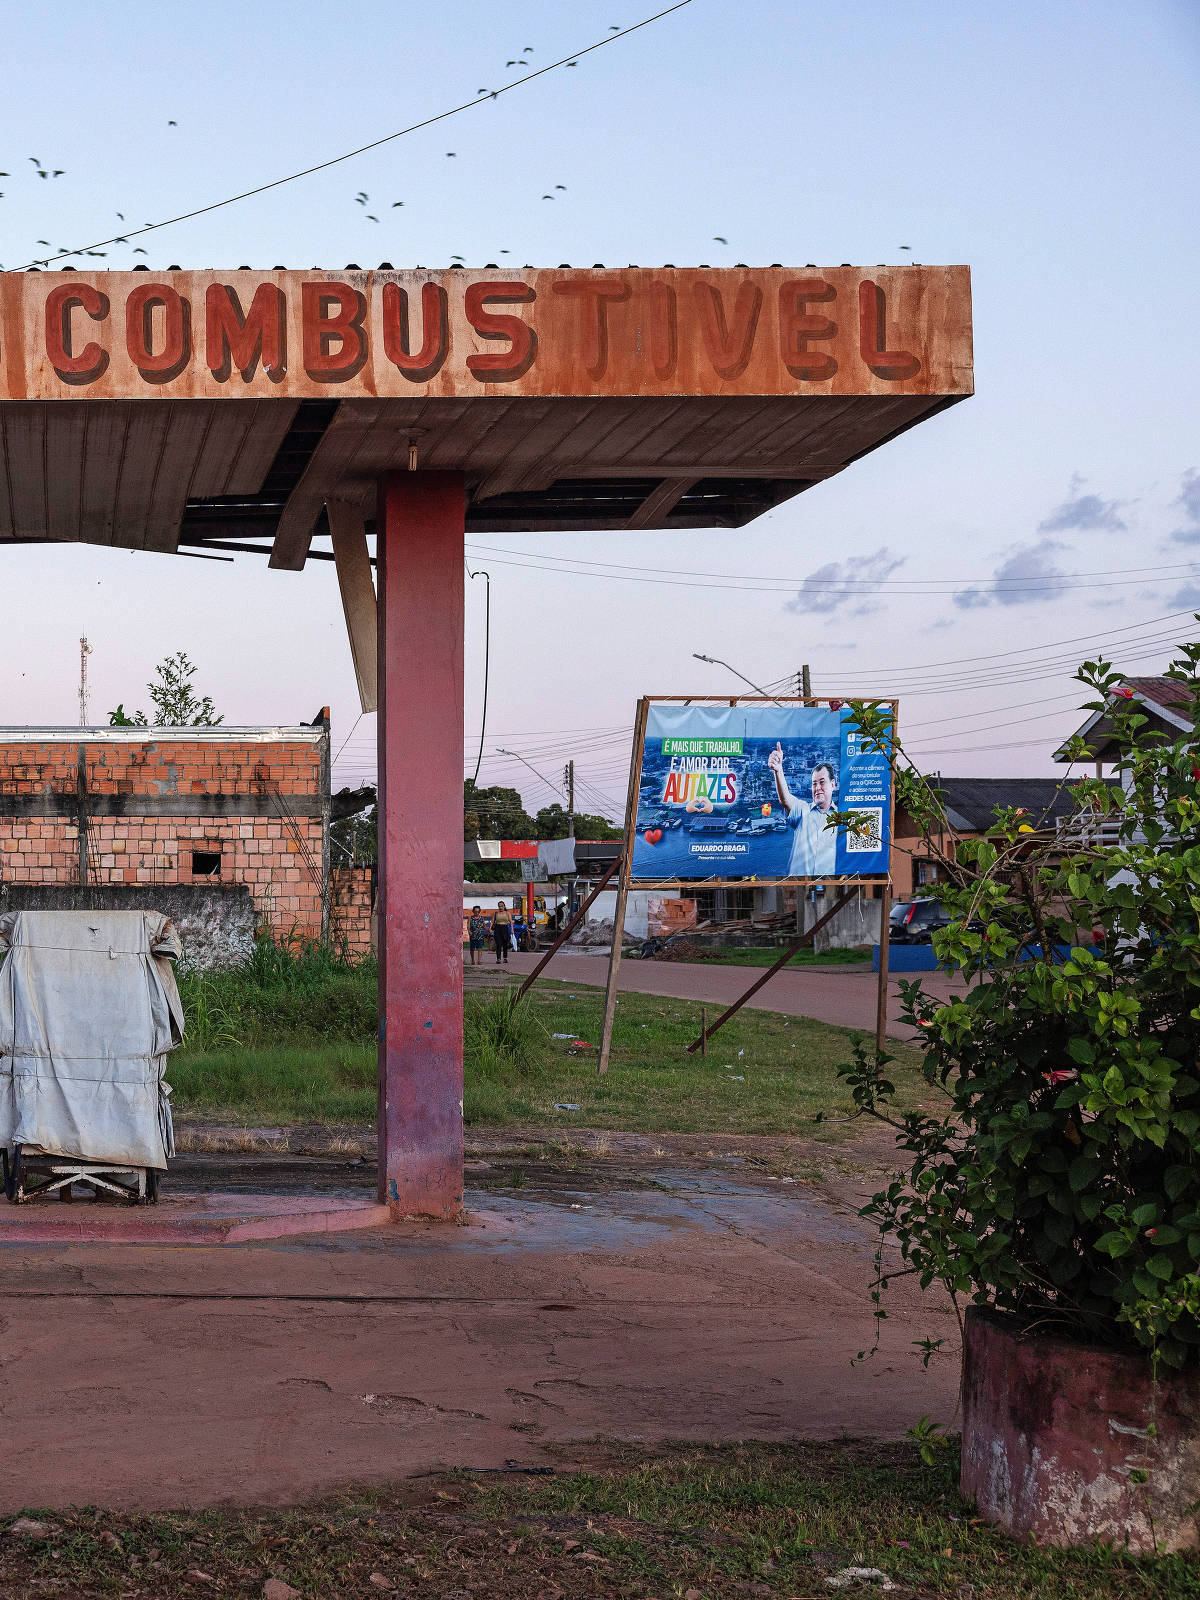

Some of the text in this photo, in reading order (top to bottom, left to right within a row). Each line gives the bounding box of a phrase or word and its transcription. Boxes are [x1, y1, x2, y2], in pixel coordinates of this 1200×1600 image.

[44, 279, 922, 386] COMBUSTIVEL
[664, 738, 742, 754] É MAIS QUE TRABALHO,
[670, 754, 730, 772] É AMOR POR
[663, 772, 737, 804] AUTAZES
[691, 844, 746, 852] EDUARDO BRAGA
